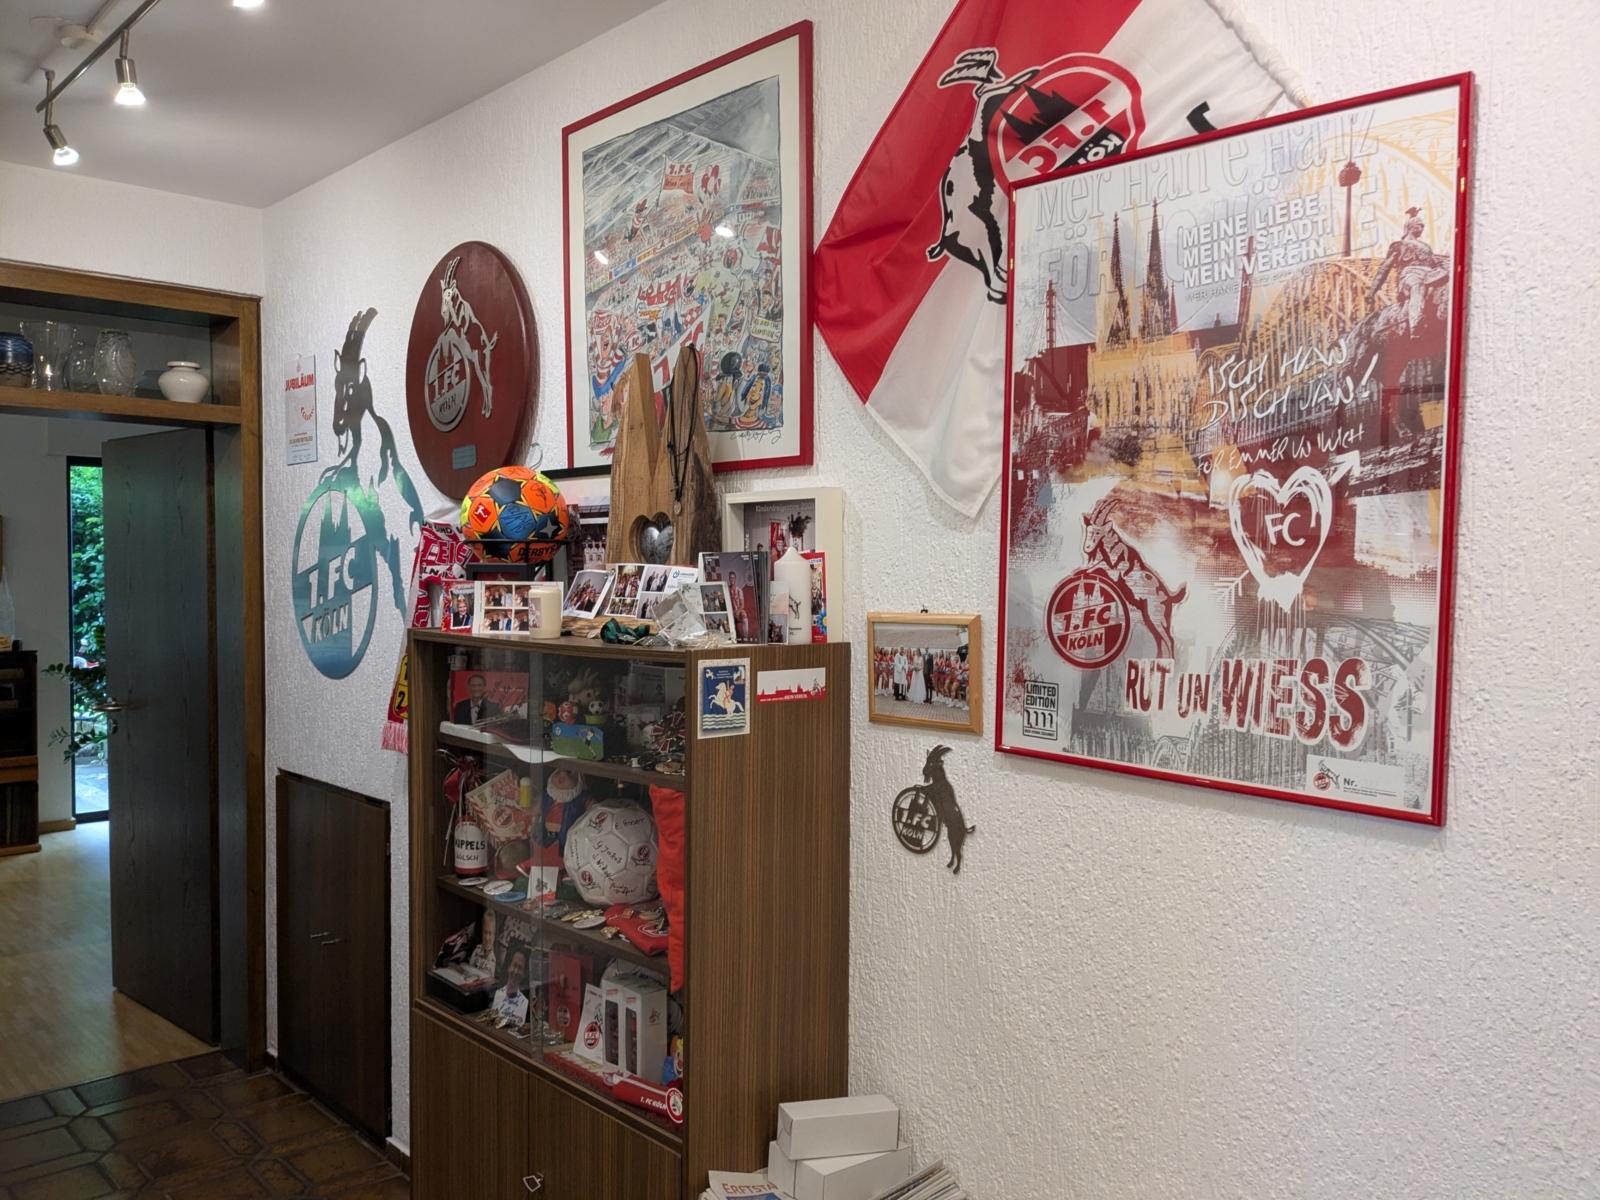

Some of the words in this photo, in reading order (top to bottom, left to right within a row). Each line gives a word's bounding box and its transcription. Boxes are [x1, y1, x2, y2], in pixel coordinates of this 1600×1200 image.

[1182, 213, 1248, 248] MEINE
[1182, 236, 1248, 268] MEINE
[1183, 260, 1236, 289] MEIN
[1208, 354, 1267, 394] ISCH
[1280, 338, 1347, 377] HAN
[1200, 382, 1290, 430] DISCH
[1264, 512, 1306, 547] FC
[308, 546, 356, 609] 1.FC
[311, 602, 349, 643] KÖLN
[1063, 605, 1111, 633] 1.FC
[1068, 631, 1104, 651] KÖLN
[1025, 695, 1056, 709] EDITION
[1026, 683, 1056, 697] LIMITED
[1125, 658, 1173, 713] RUT
[1177, 672, 1211, 719] UN
[1221, 657, 1371, 749] WIESS
[1343, 777, 1358, 787] Nr.
[901, 811, 932, 829] 1.FC
